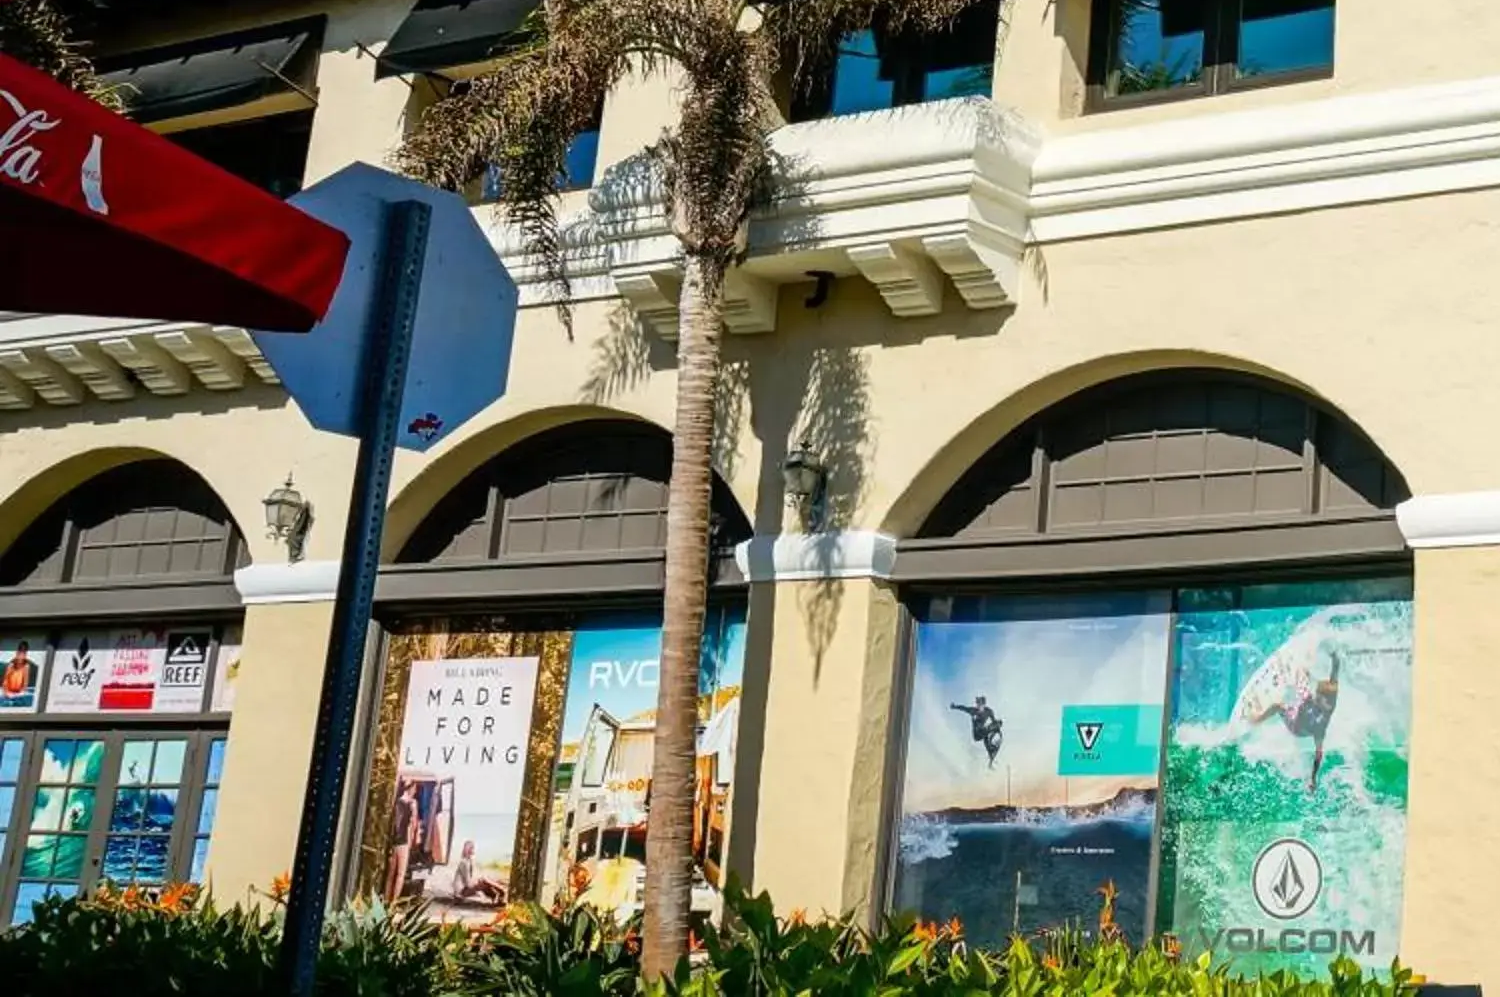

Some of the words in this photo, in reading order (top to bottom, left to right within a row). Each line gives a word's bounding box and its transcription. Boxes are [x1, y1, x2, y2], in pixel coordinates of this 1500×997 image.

[60, 667, 96, 689] reef
[163, 665, 203, 685] REEF
[589, 660, 661, 689] RVC
[427, 686, 513, 706] MADE
[435, 716, 496, 736] FOR
[404, 746, 519, 765] LIVING
[1200, 927, 1376, 956] VOLCOM
